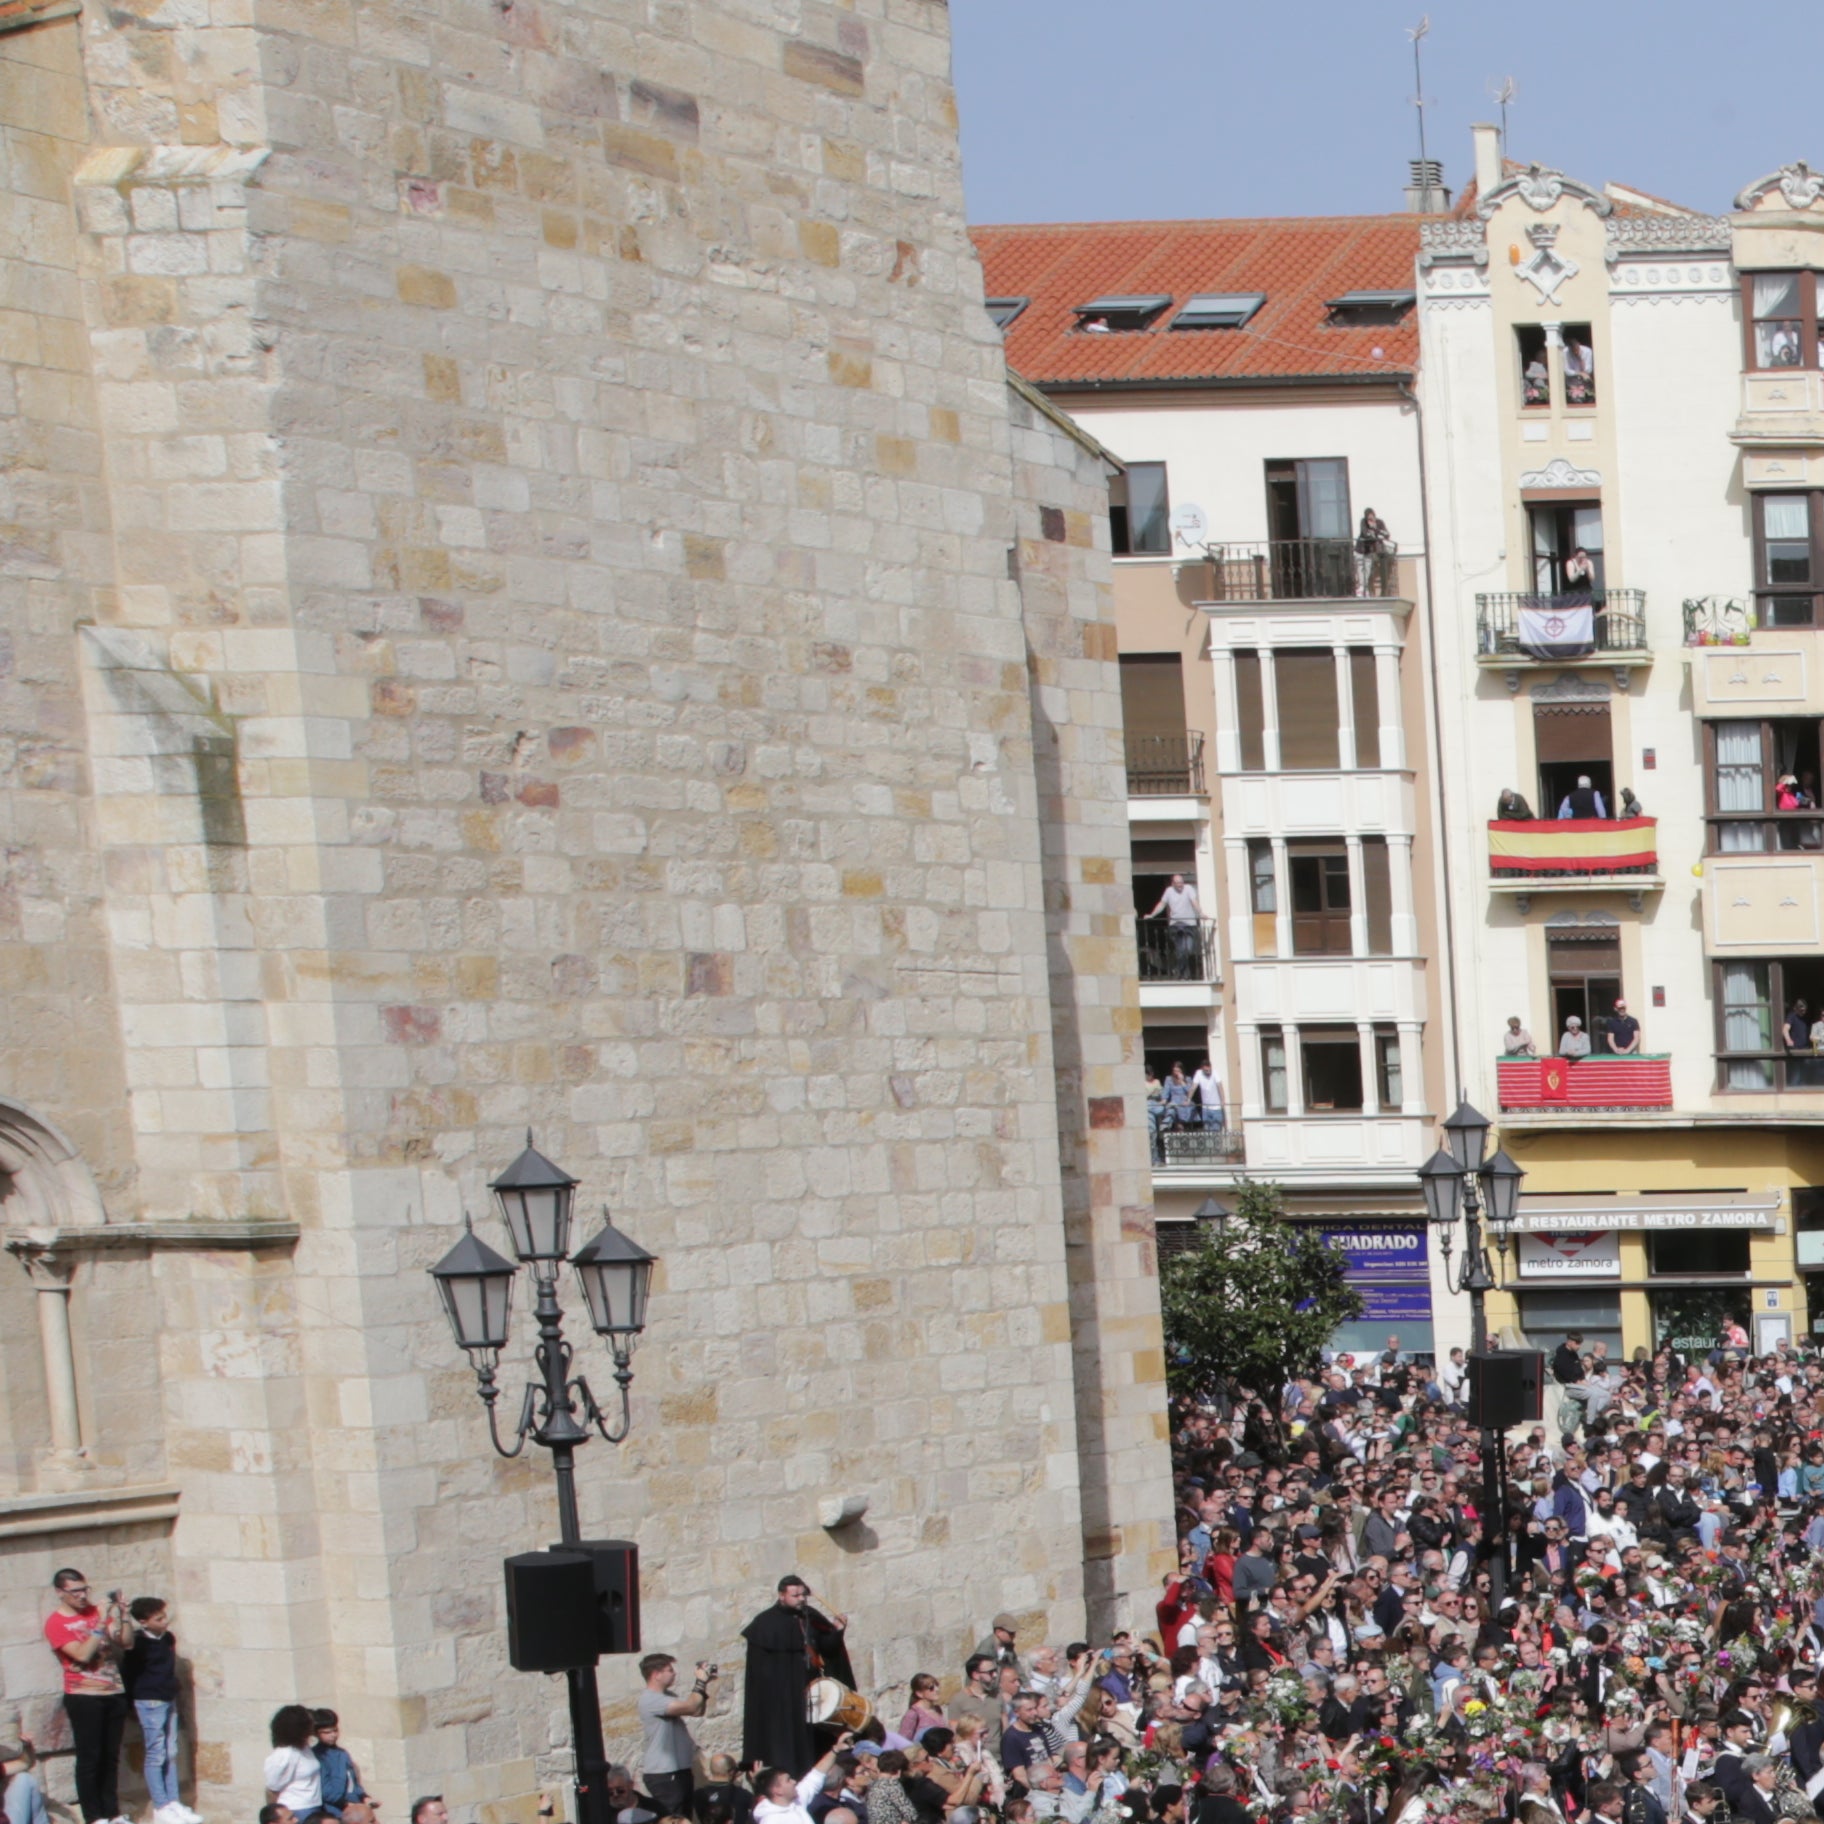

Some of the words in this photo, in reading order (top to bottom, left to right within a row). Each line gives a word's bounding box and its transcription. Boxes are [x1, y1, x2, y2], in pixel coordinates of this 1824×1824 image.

[1529, 1214, 1638, 1229] RESTAURANTE
[1643, 1213, 1696, 1228] METRO
[1701, 1212, 1767, 1226] ZAMORA
[1359, 1223, 1426, 1231] DENTAL
[1527, 1257, 1563, 1269] metro
[1567, 1258, 1613, 1268] zamora
